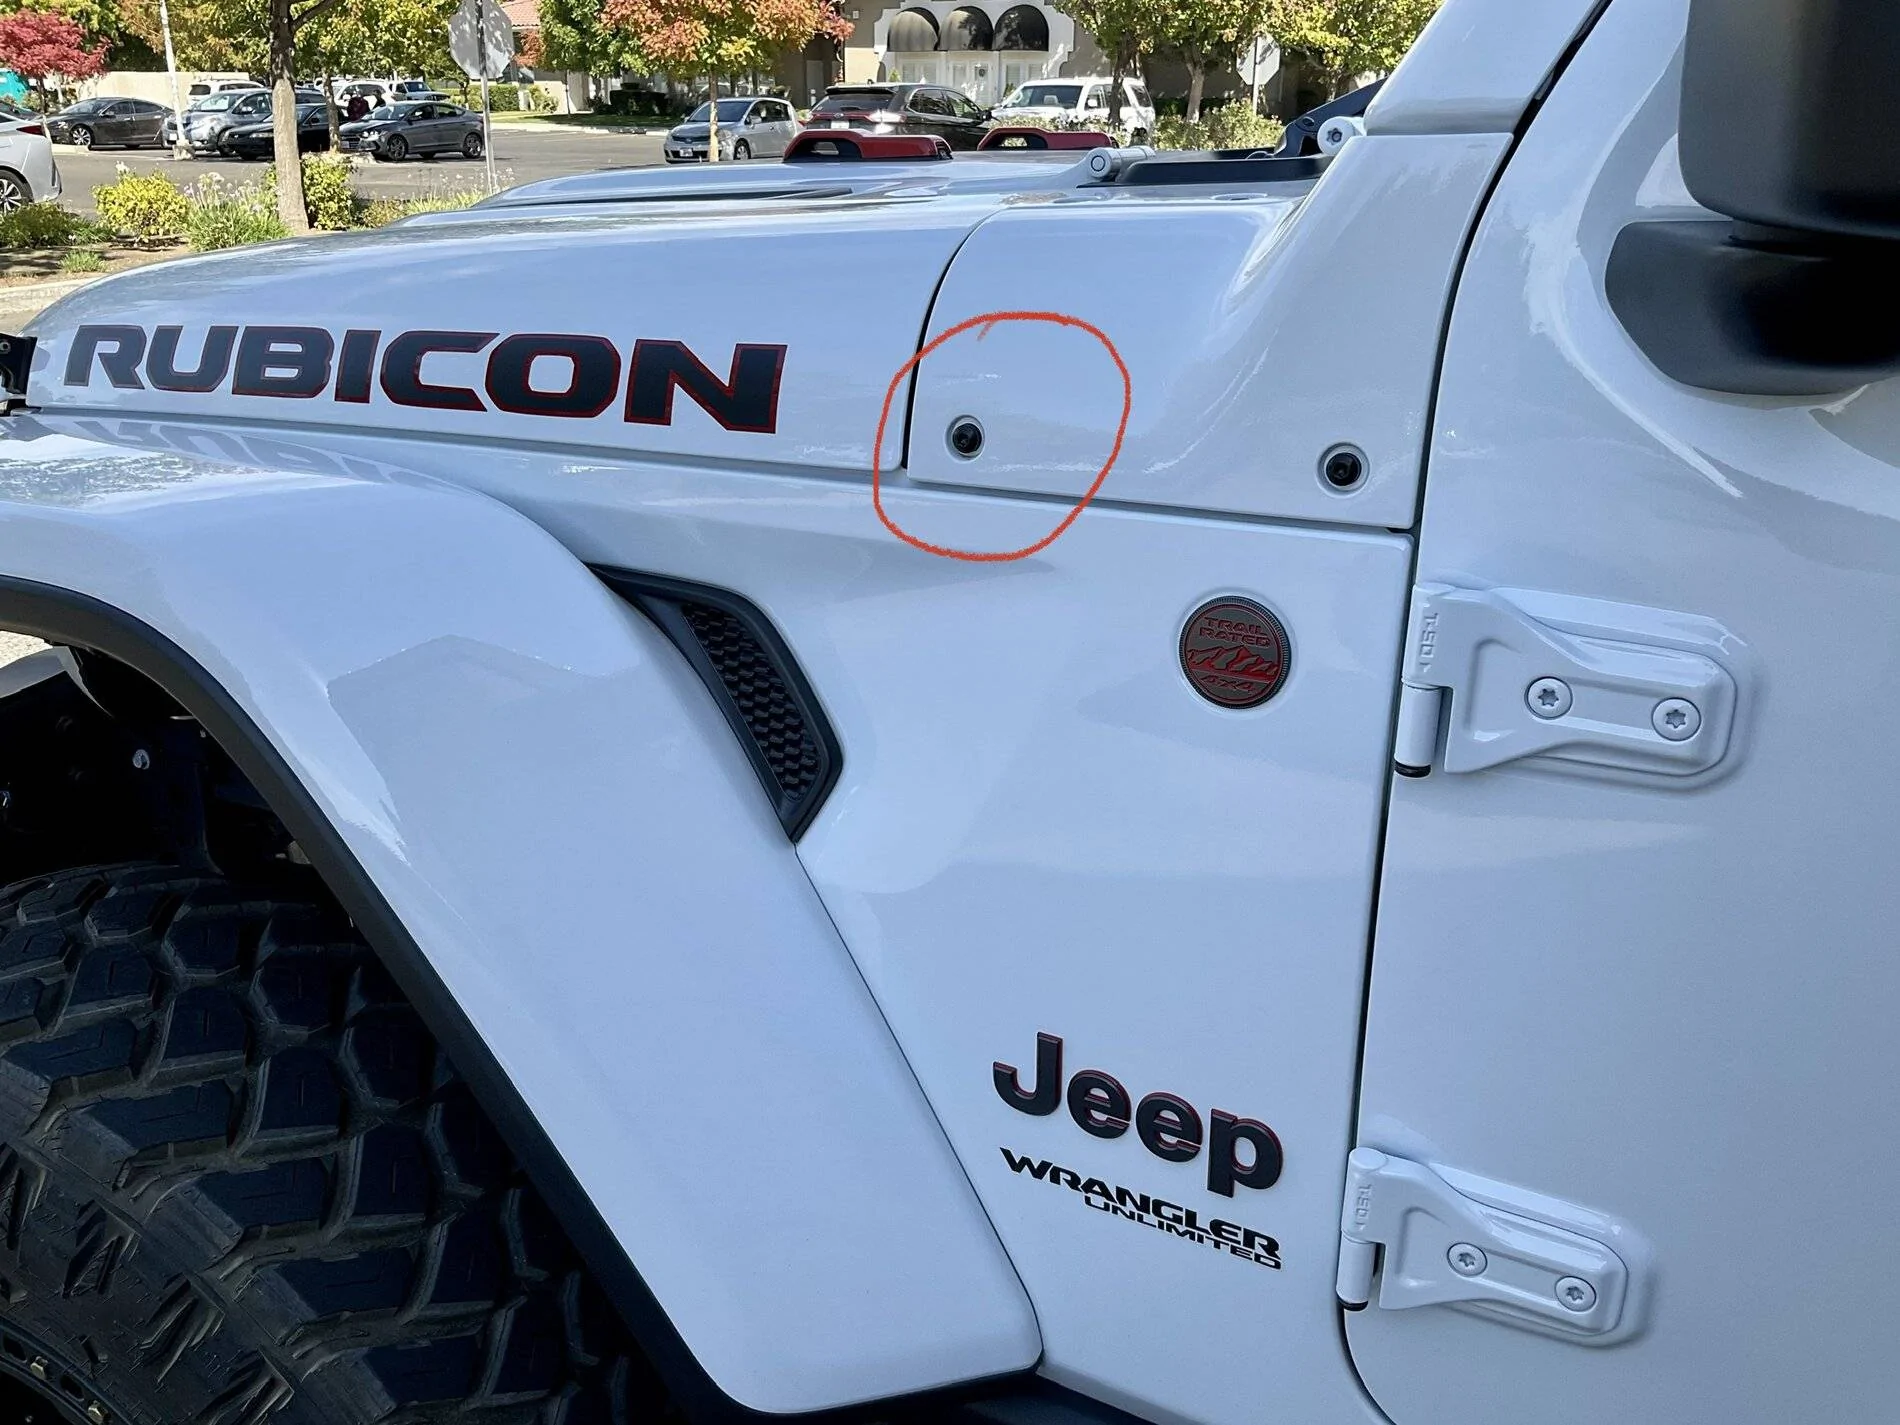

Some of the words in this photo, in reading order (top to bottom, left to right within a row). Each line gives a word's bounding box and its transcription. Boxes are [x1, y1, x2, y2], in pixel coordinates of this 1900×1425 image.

[64, 325, 788, 434] RUBICON
[1200, 627, 1271, 648] RATED
[1203, 616, 1268, 637] TRAIL
[993, 1032, 1283, 1198] Jeep
[1000, 1147, 1281, 1260] WRANGLER
[1084, 1195, 1281, 1270] UNLIMITED
